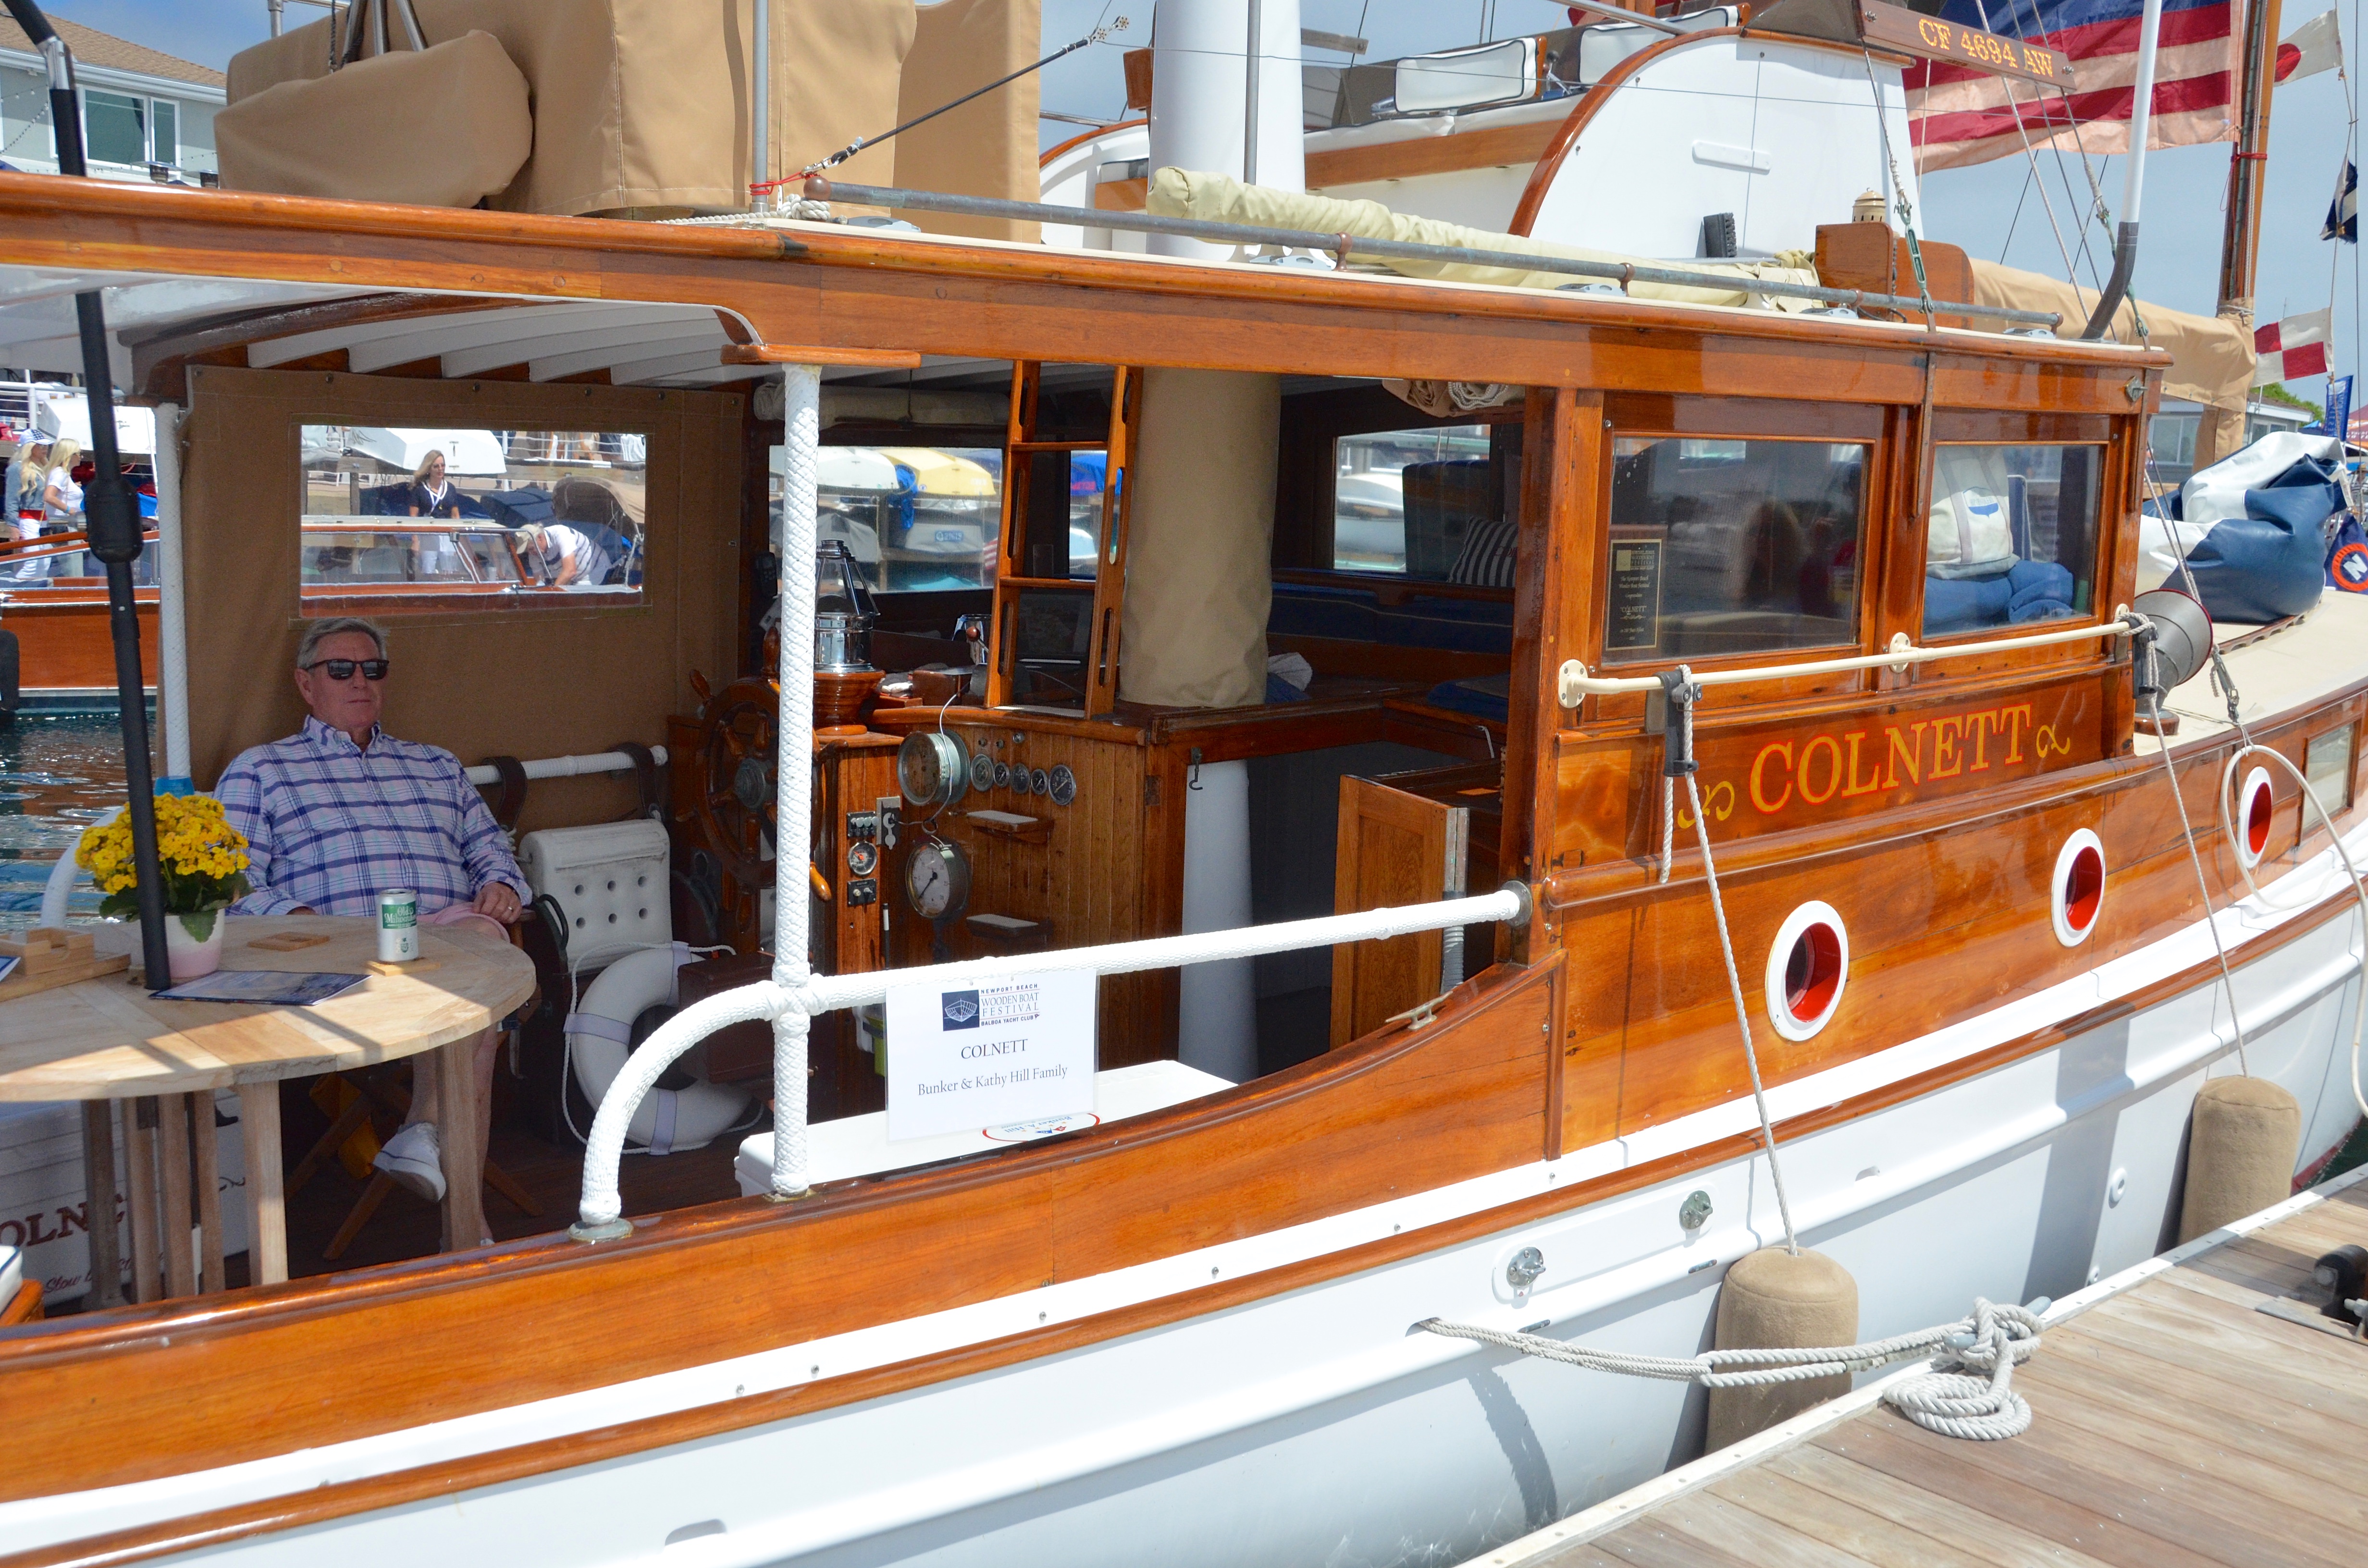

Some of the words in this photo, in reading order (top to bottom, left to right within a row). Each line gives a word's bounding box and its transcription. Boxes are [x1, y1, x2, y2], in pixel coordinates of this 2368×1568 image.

[1919, 18, 1951, 50] CF
[1961, 31, 2018, 68] 4694
[2023, 48, 2053, 77] AW
[2343, 553, 2368, 581] N
[1750, 704, 2032, 815] COLNETT
[397, 906, 409, 916] Old
[981, 995, 1017, 1006] WOODEN
[1019, 992, 1039, 1003] BOAT
[983, 1002, 1039, 1017] FESTIVAL
[961, 1039, 1028, 1059] COLNETT
[918, 1081, 958, 1096] Bunker
[961, 1078, 972, 1090] &
[975, 1072, 1007, 1089] Kathy
[1010, 1068, 1029, 1082] Hill
[1033, 1065, 1068, 1080] Family
